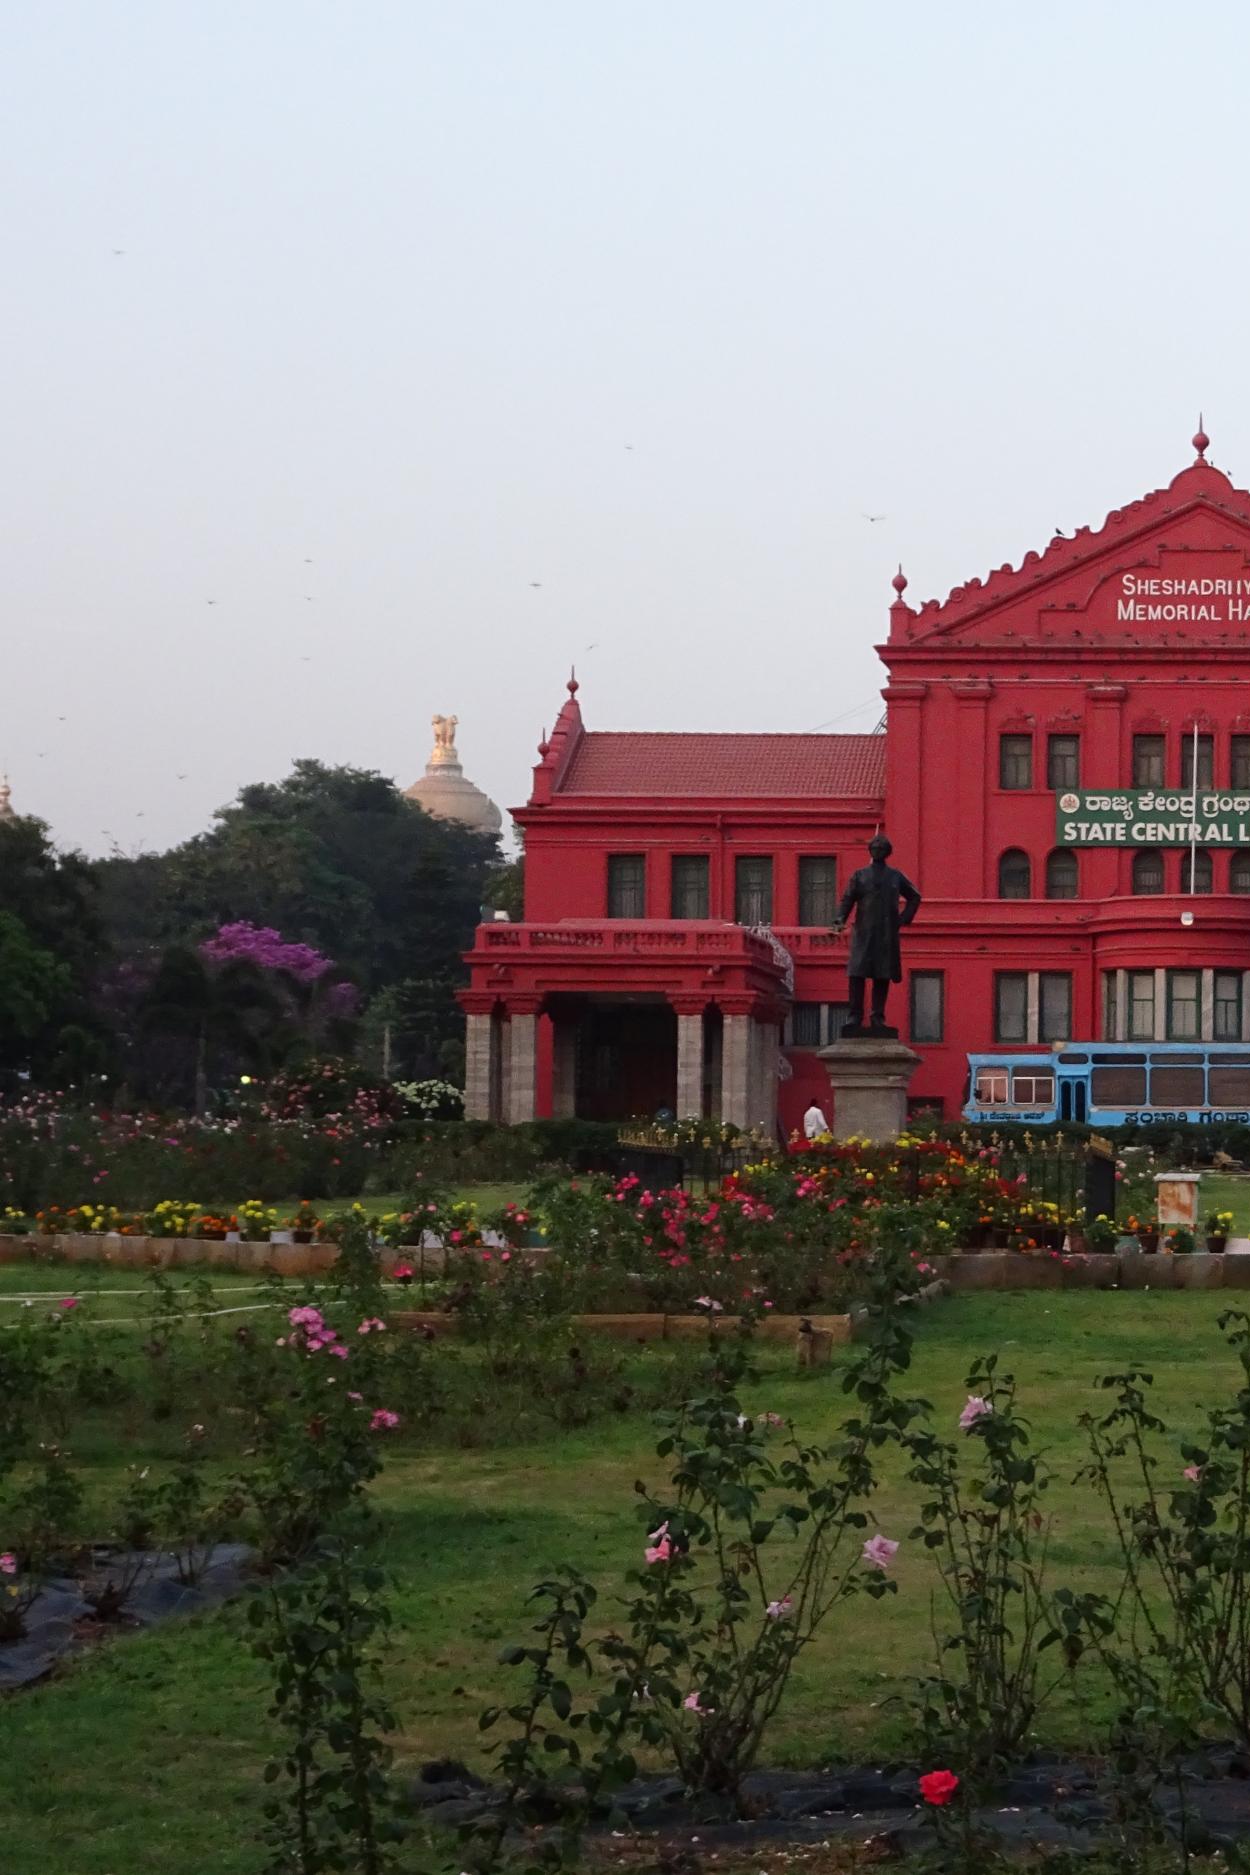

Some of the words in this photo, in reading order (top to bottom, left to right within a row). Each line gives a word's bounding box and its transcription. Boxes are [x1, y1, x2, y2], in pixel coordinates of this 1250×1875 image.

[1122, 574, 1231, 596] SHESHADRI
[1117, 599, 1221, 620] MEMORIAL
[1085, 796, 1133, 820] ರಾಜ್ಯ
[1138, 792, 1195, 817] ಕೇಂದ್ರ
[1063, 822, 1126, 841] STATE
[1131, 823, 1233, 841] CENTRAL
